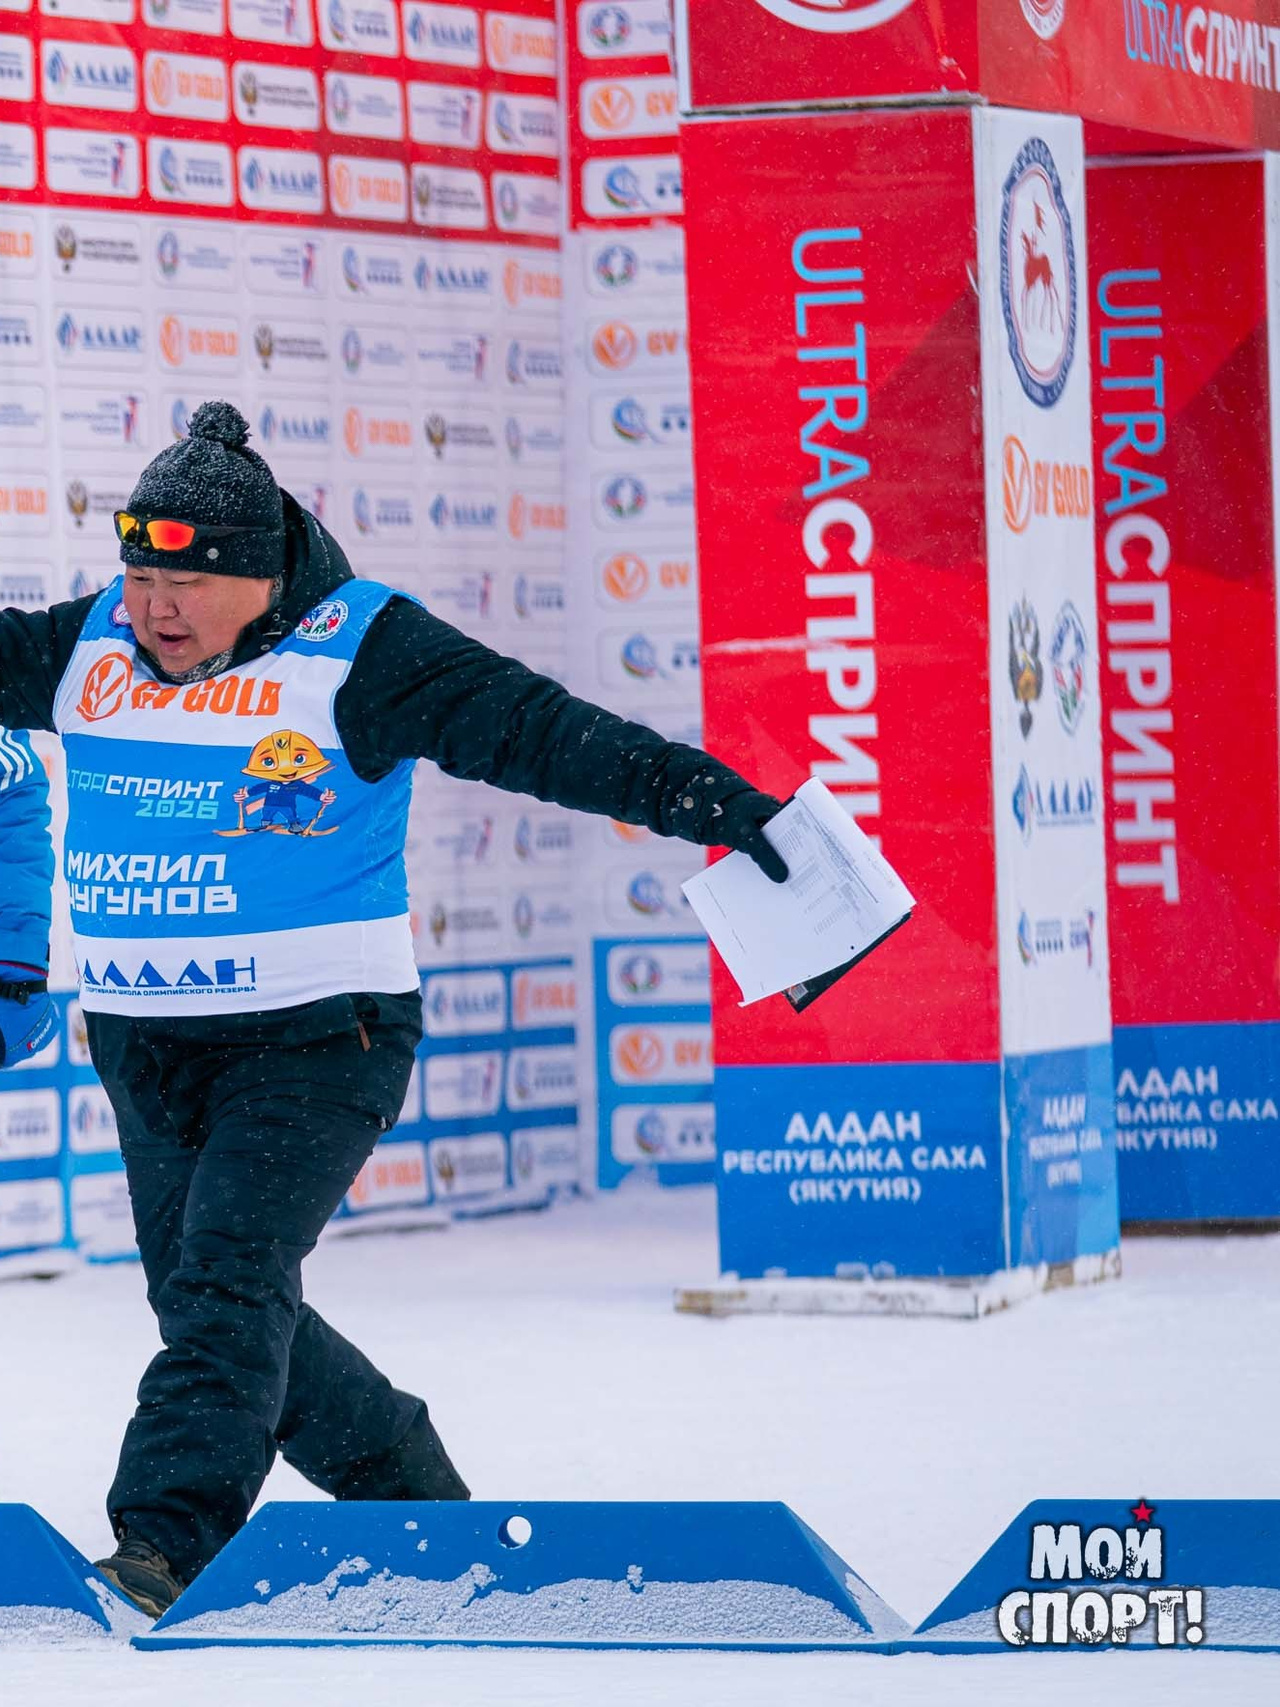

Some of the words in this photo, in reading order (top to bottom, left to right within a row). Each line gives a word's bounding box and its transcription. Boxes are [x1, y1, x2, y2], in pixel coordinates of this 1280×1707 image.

[792, 227, 882, 853] ULTRAСПРИ
[1097, 267, 1180, 904] ULTRAСПРИНТ
[182, 675, 283, 717] GOLD
[67, 769, 224, 800] TRAСПРИНТ
[135, 799, 220, 821] 2026
[67, 849, 227, 883] МИХАИЛ
[84, 956, 256, 988] АЛДАН
[143, 986, 214, 997] ОЛИМПИЙСКОГО
[214, 986, 257, 995] РЕЗЕРВА
[1116, 1065, 1219, 1101] ЛДАН
[1116, 1100, 1202, 1125] БЛИКА
[1209, 1098, 1279, 1122] САХА
[785, 1111, 922, 1146] АЛДАН
[723, 1147, 903, 1175] РЕСПУБЛИКА
[912, 1145, 987, 1171] САХА
[788, 1177, 922, 1205] (ЯКУТИЯ)
